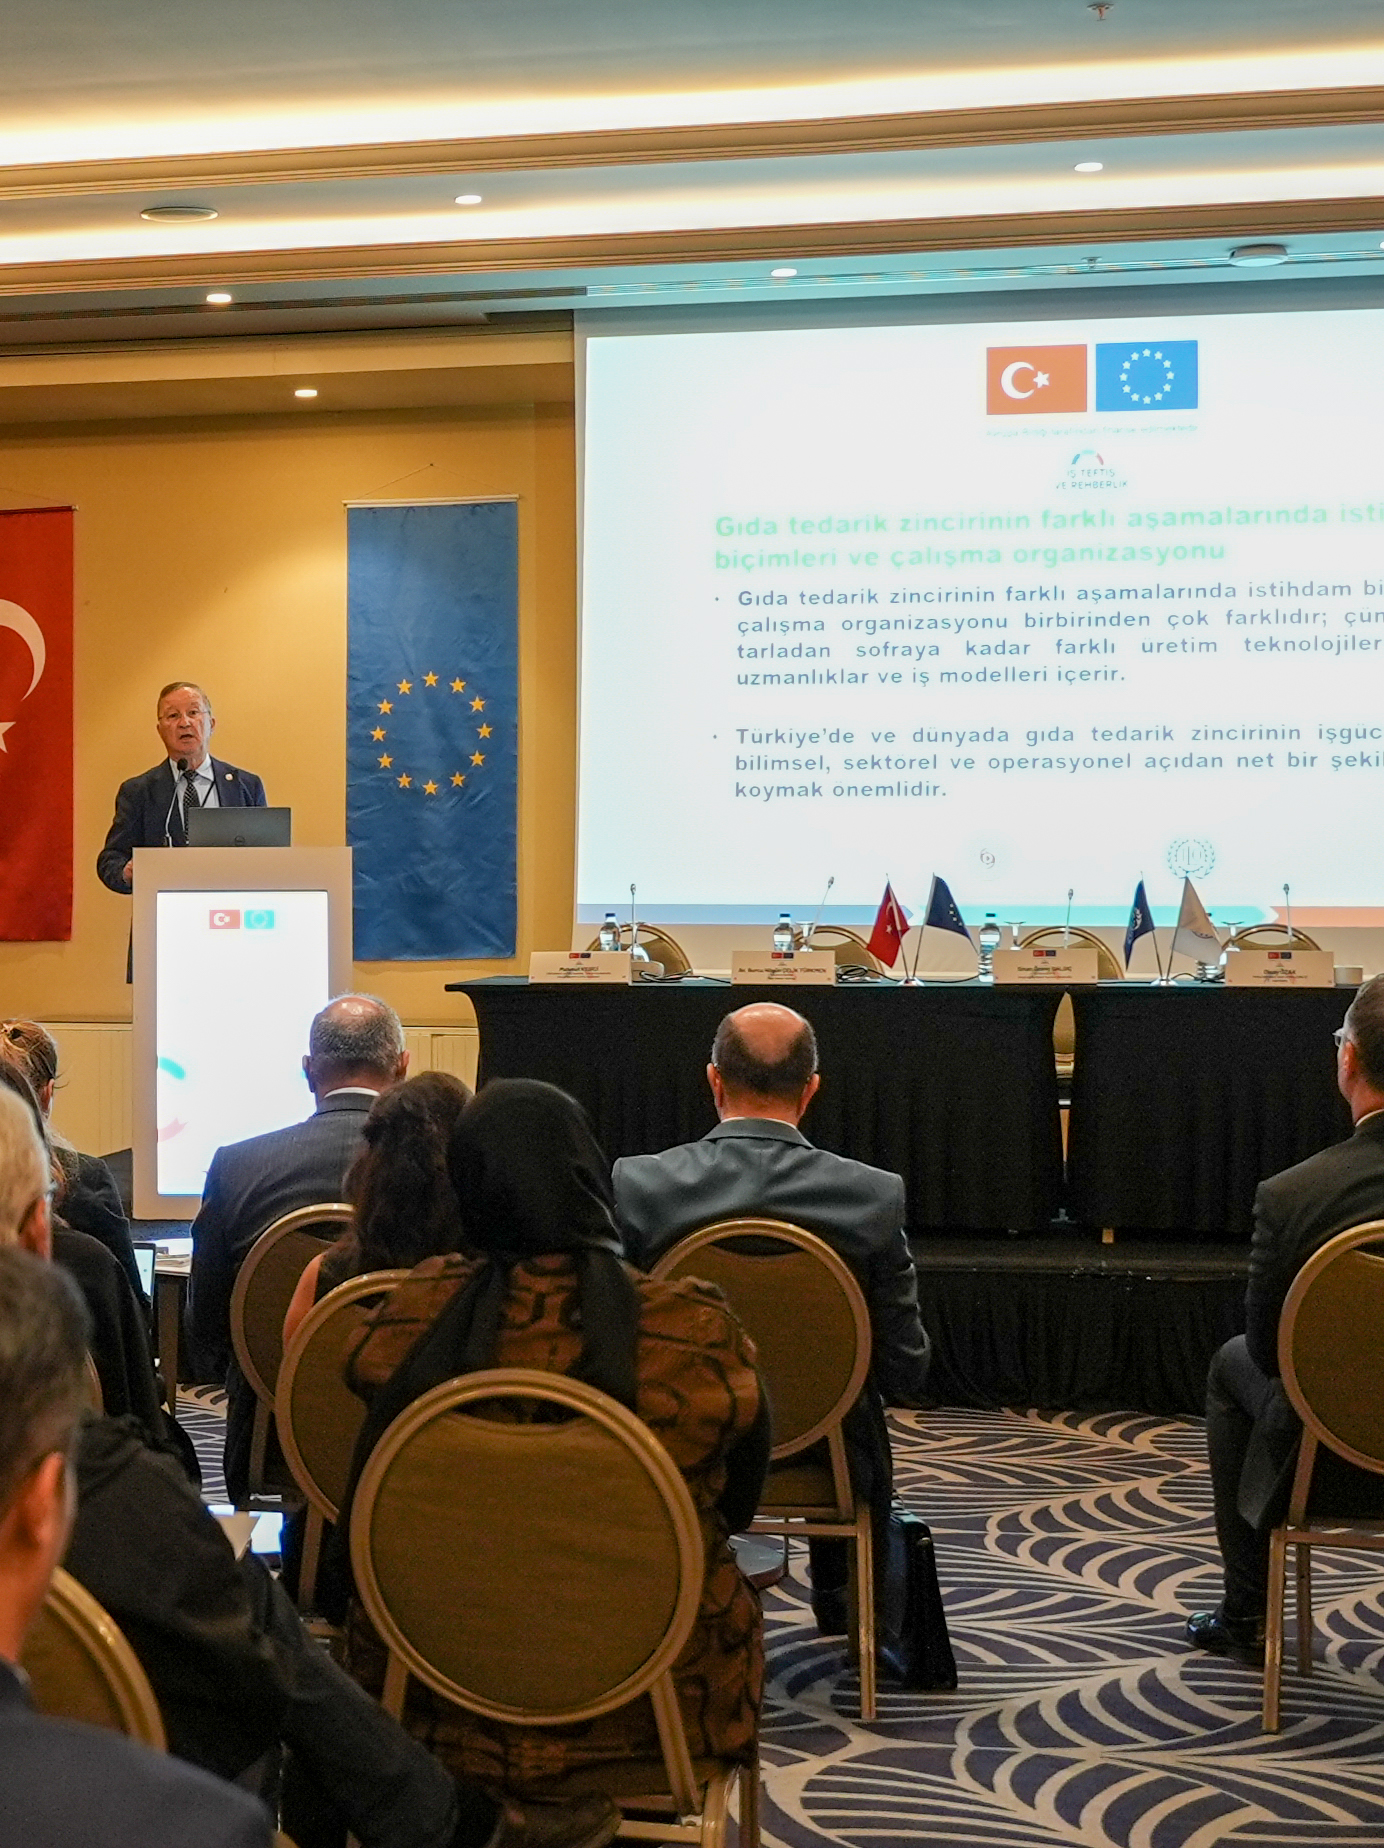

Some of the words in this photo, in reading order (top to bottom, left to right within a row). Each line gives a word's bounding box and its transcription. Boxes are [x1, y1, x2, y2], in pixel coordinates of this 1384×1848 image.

[716, 516, 778, 536] Gıda
[789, 514, 887, 534] tedarik
[900, 512, 1030, 532] zincirinin
[1042, 508, 1114, 529] farklı
[1128, 505, 1327, 531] aşamalarında
[716, 549, 836, 573] biçimleri
[848, 552, 879, 566] ve
[890, 546, 1002, 569] çalışma
[1014, 543, 1224, 568] organizasyonu
[738, 590, 787, 606] Gıda
[800, 589, 878, 605] tedarik
[890, 587, 994, 603] zincirinin
[1006, 585, 1064, 601] farklı
[1077, 583, 1235, 604] aşamalarında
[1249, 581, 1351, 597] istihdam
[1364, 580, 1382, 595] bi
[738, 617, 824, 636] çalışma
[842, 613, 1007, 635] organizasyonu
[1025, 611, 1149, 627] birbirinden
[1168, 610, 1208, 630] çok
[1226, 608, 1326, 627] farklıdır;
[737, 643, 830, 658] tarladan
[857, 642, 939, 661] sofraya
[966, 640, 1030, 655] kadar
[1056, 638, 1114, 654] farklı
[1142, 637, 1216, 653] üretim
[1244, 635, 1382, 655] teknolojiler
[738, 668, 868, 685] uzmanlıklar
[878, 671, 902, 683] ve
[913, 667, 929, 687] iş
[940, 665, 1046, 682] modelleri
[1058, 665, 1124, 685] içerir.
[872, 731, 895, 743] ve
[913, 727, 1008, 747] dünyada
[1026, 726, 1073, 746] gıda
[1092, 725, 1173, 741] tedarik
[1192, 724, 1300, 740] zincirinin
[1319, 724, 1382, 744] işgüc
[736, 755, 830, 773] bilimsel,
[951, 757, 975, 769] ve
[989, 753, 1130, 773] operasyonel
[1145, 752, 1222, 772] açıdan
[1237, 752, 1273, 767] net
[1288, 752, 1318, 767] bir
[736, 782, 822, 802] koymak
